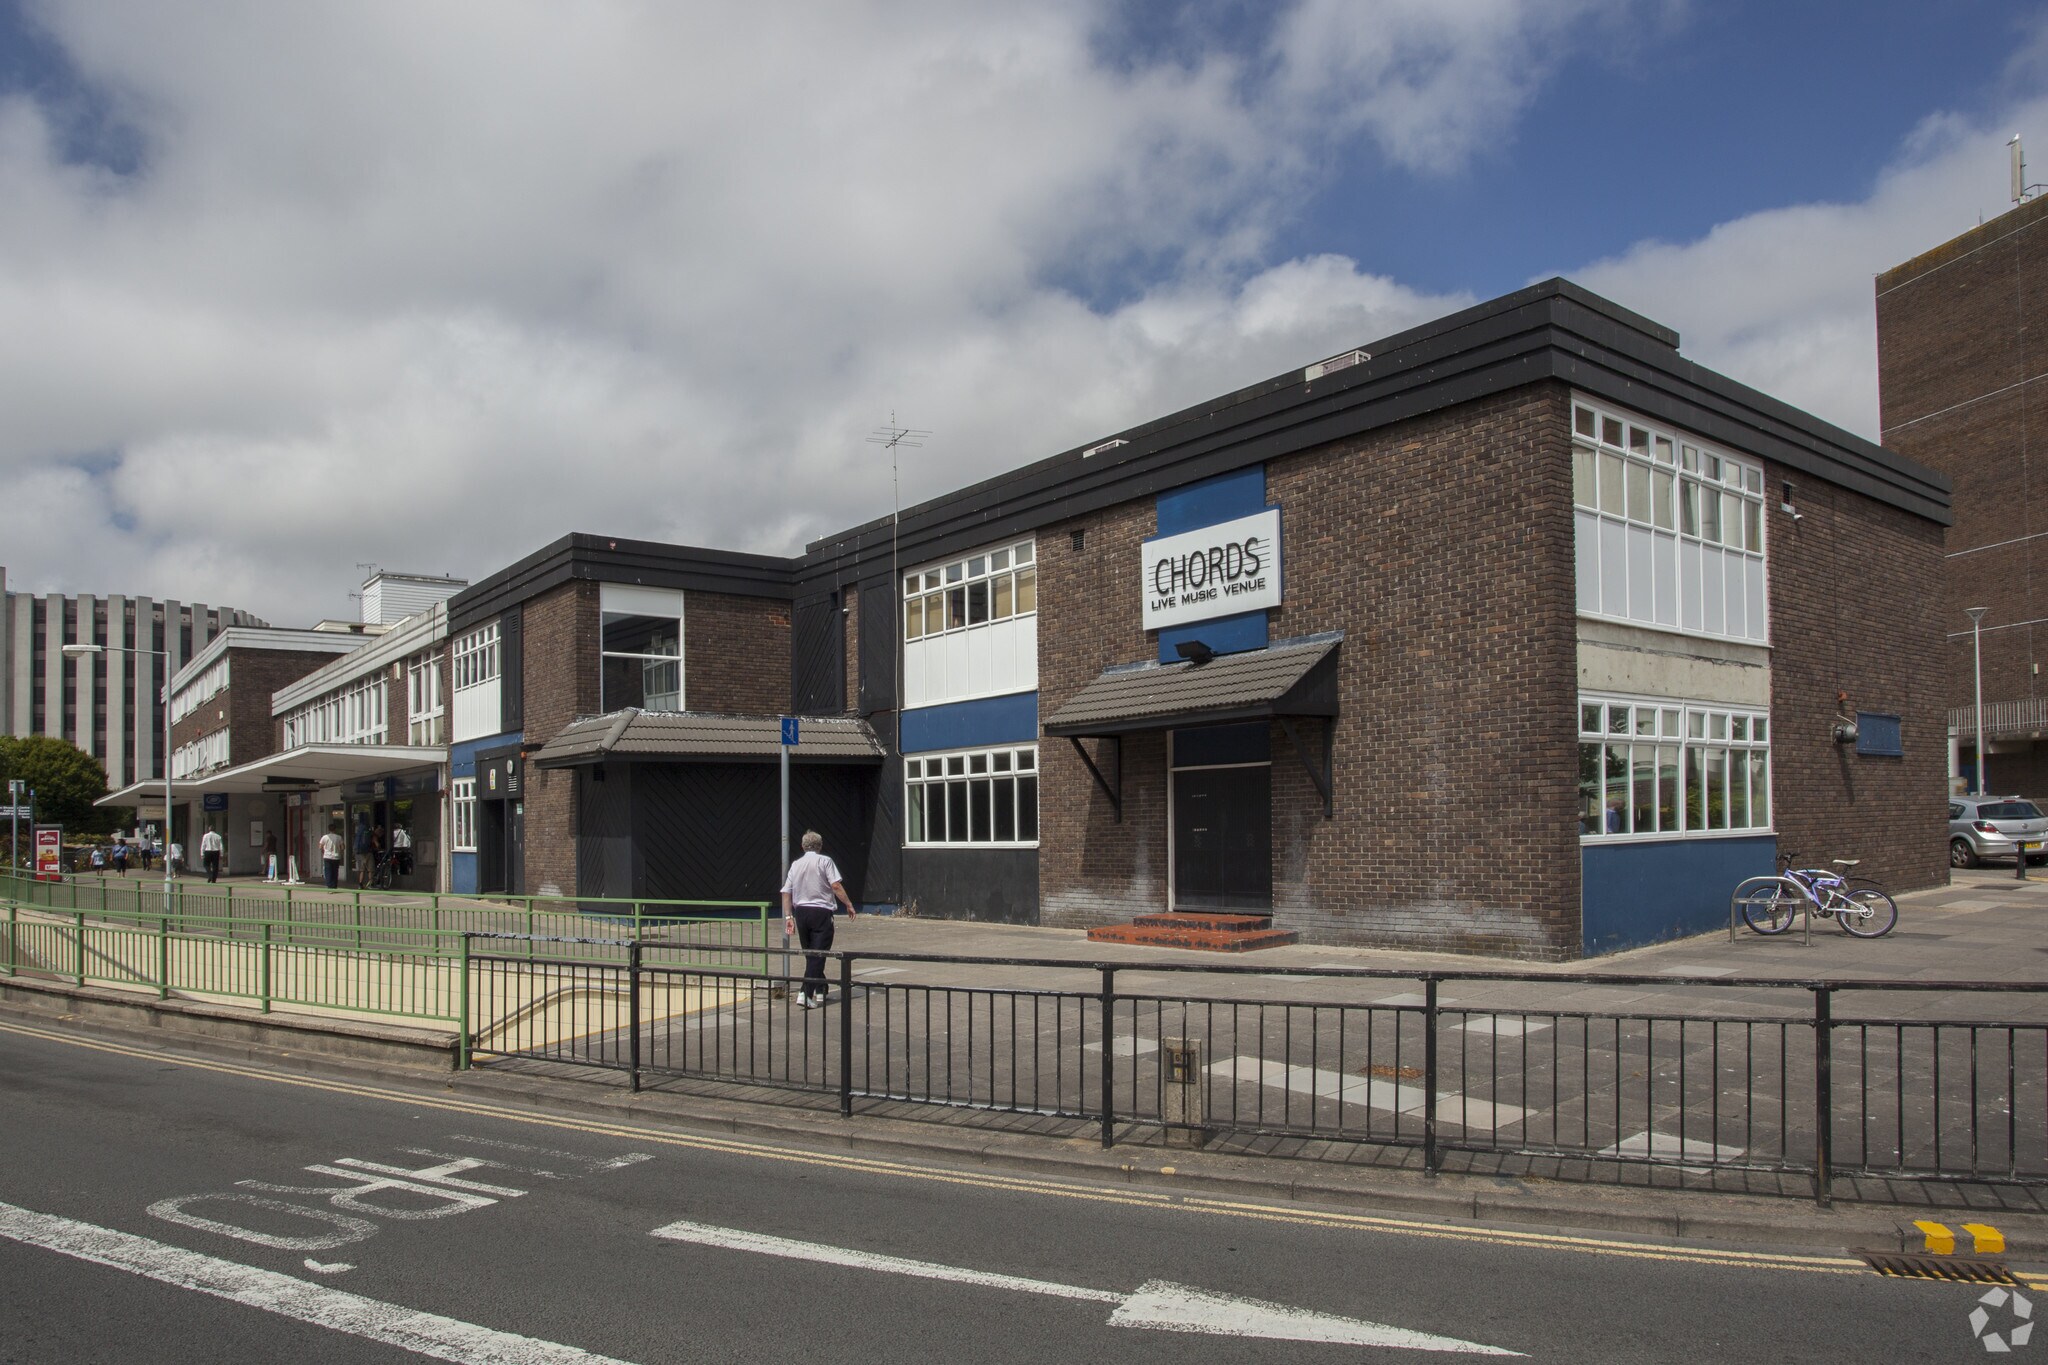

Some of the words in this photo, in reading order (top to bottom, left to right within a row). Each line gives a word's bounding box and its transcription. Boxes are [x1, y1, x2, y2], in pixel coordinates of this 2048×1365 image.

[1155, 537, 1260, 597] CHORDS
[1151, 597, 1177, 611] LIVE
[1181, 588, 1218, 606] MUSIC
[1223, 577, 1266, 597] VENUE
